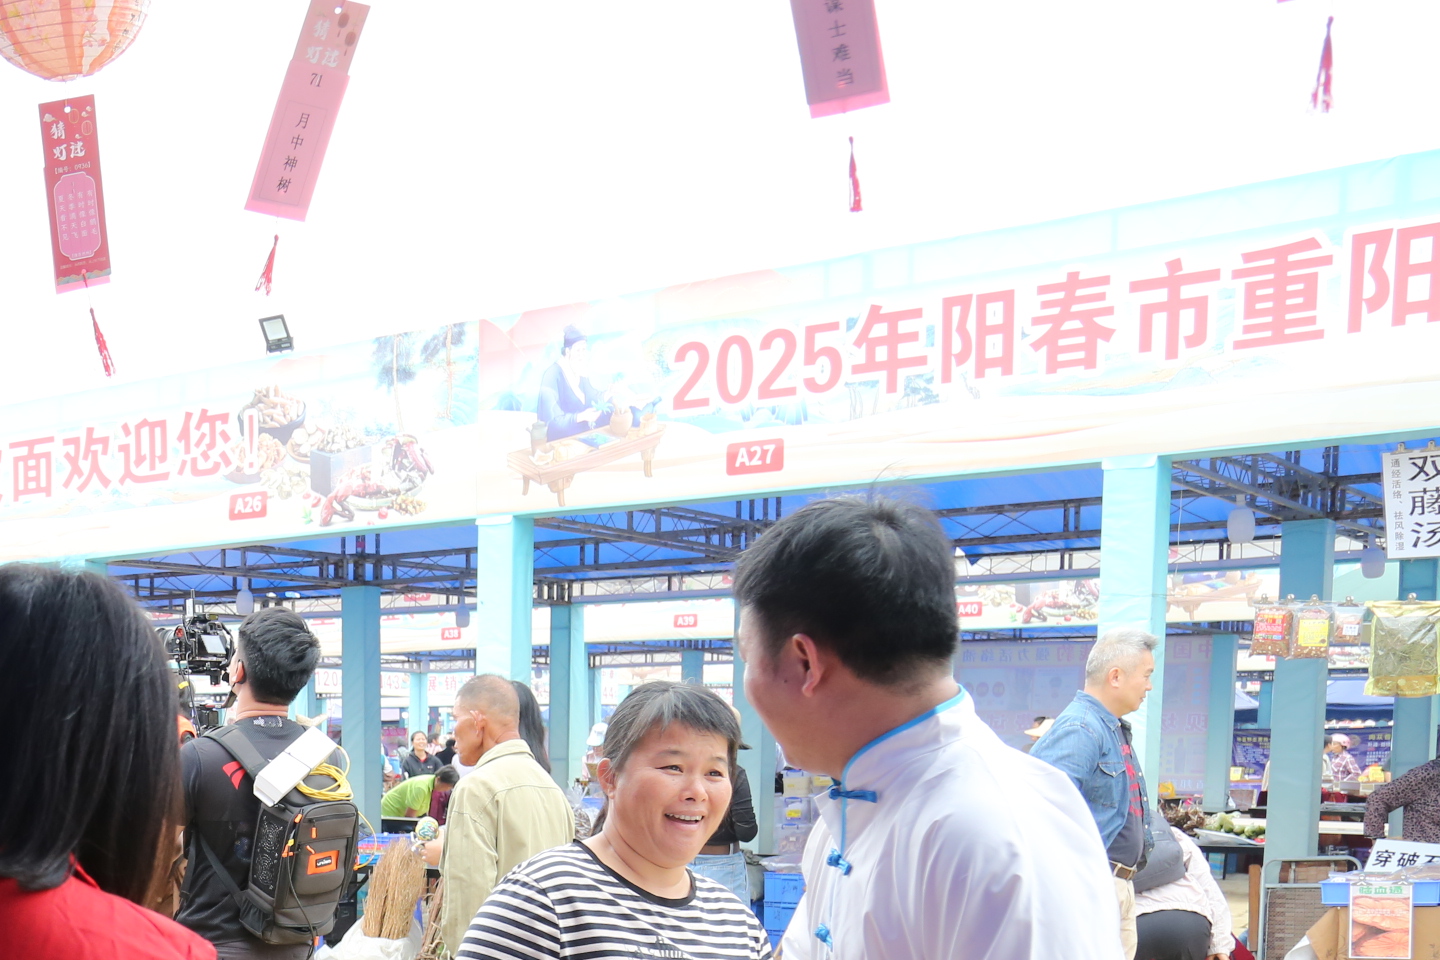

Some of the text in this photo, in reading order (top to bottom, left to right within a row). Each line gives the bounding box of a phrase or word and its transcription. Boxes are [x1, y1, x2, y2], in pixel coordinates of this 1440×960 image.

[313, 19, 331, 40] 猜
[310, 73, 323, 87] 71
[50, 120, 66, 140] 猜
[276, 112, 310, 193] 月中神树
[672, 221, 1440, 412] 2025年阳春市重阳
[734, 443, 776, 468] A27
[233, 495, 262, 514] A26
[677, 616, 695, 626] A39
